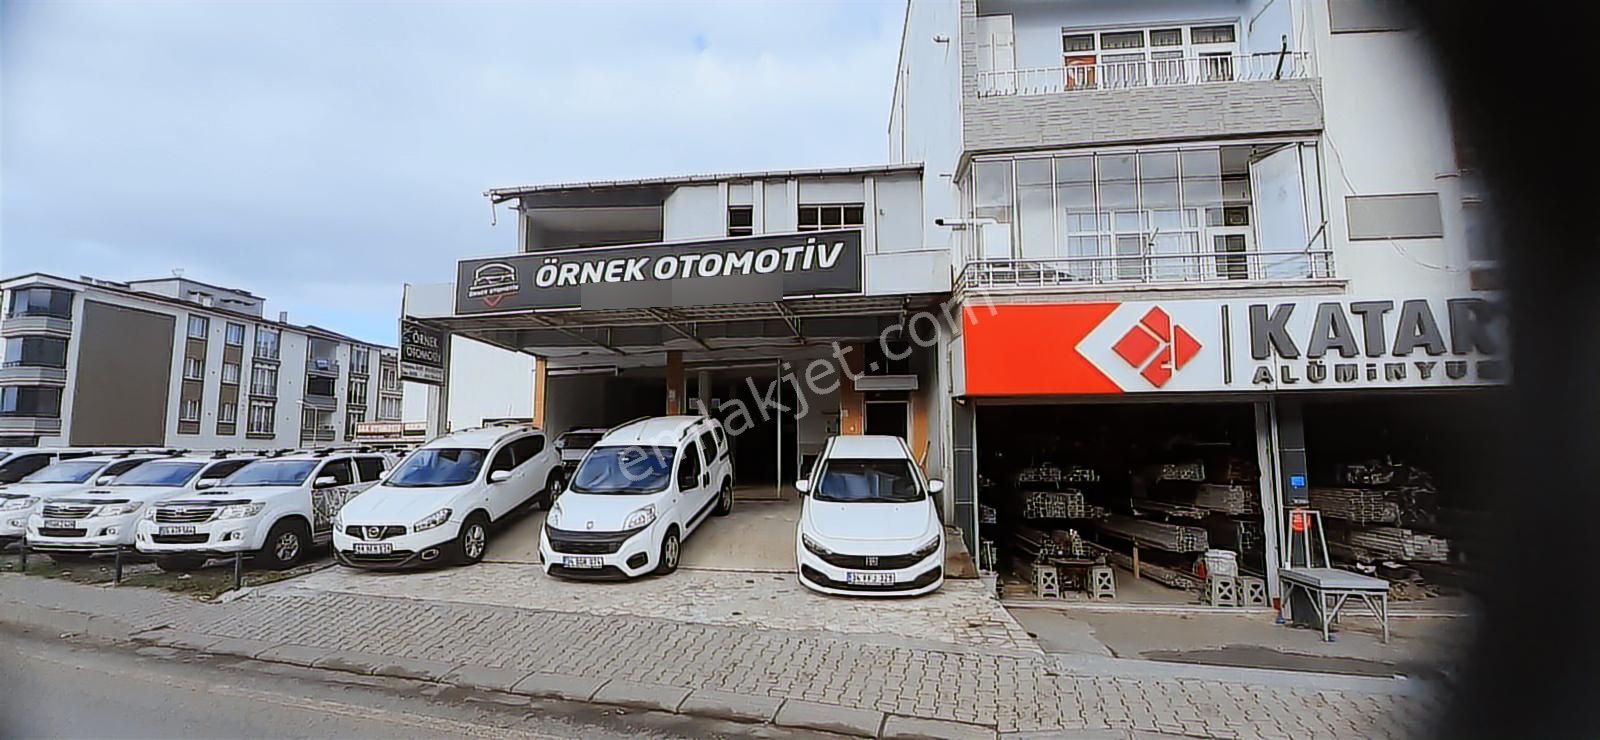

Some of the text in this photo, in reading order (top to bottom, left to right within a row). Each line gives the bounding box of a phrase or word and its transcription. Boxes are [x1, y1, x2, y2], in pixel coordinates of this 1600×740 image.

[535, 237, 845, 288] ÖRNEK OTOMOTİV
[412, 329, 441, 349] ÖRNEK
[1249, 298, 1498, 359] KATAR
